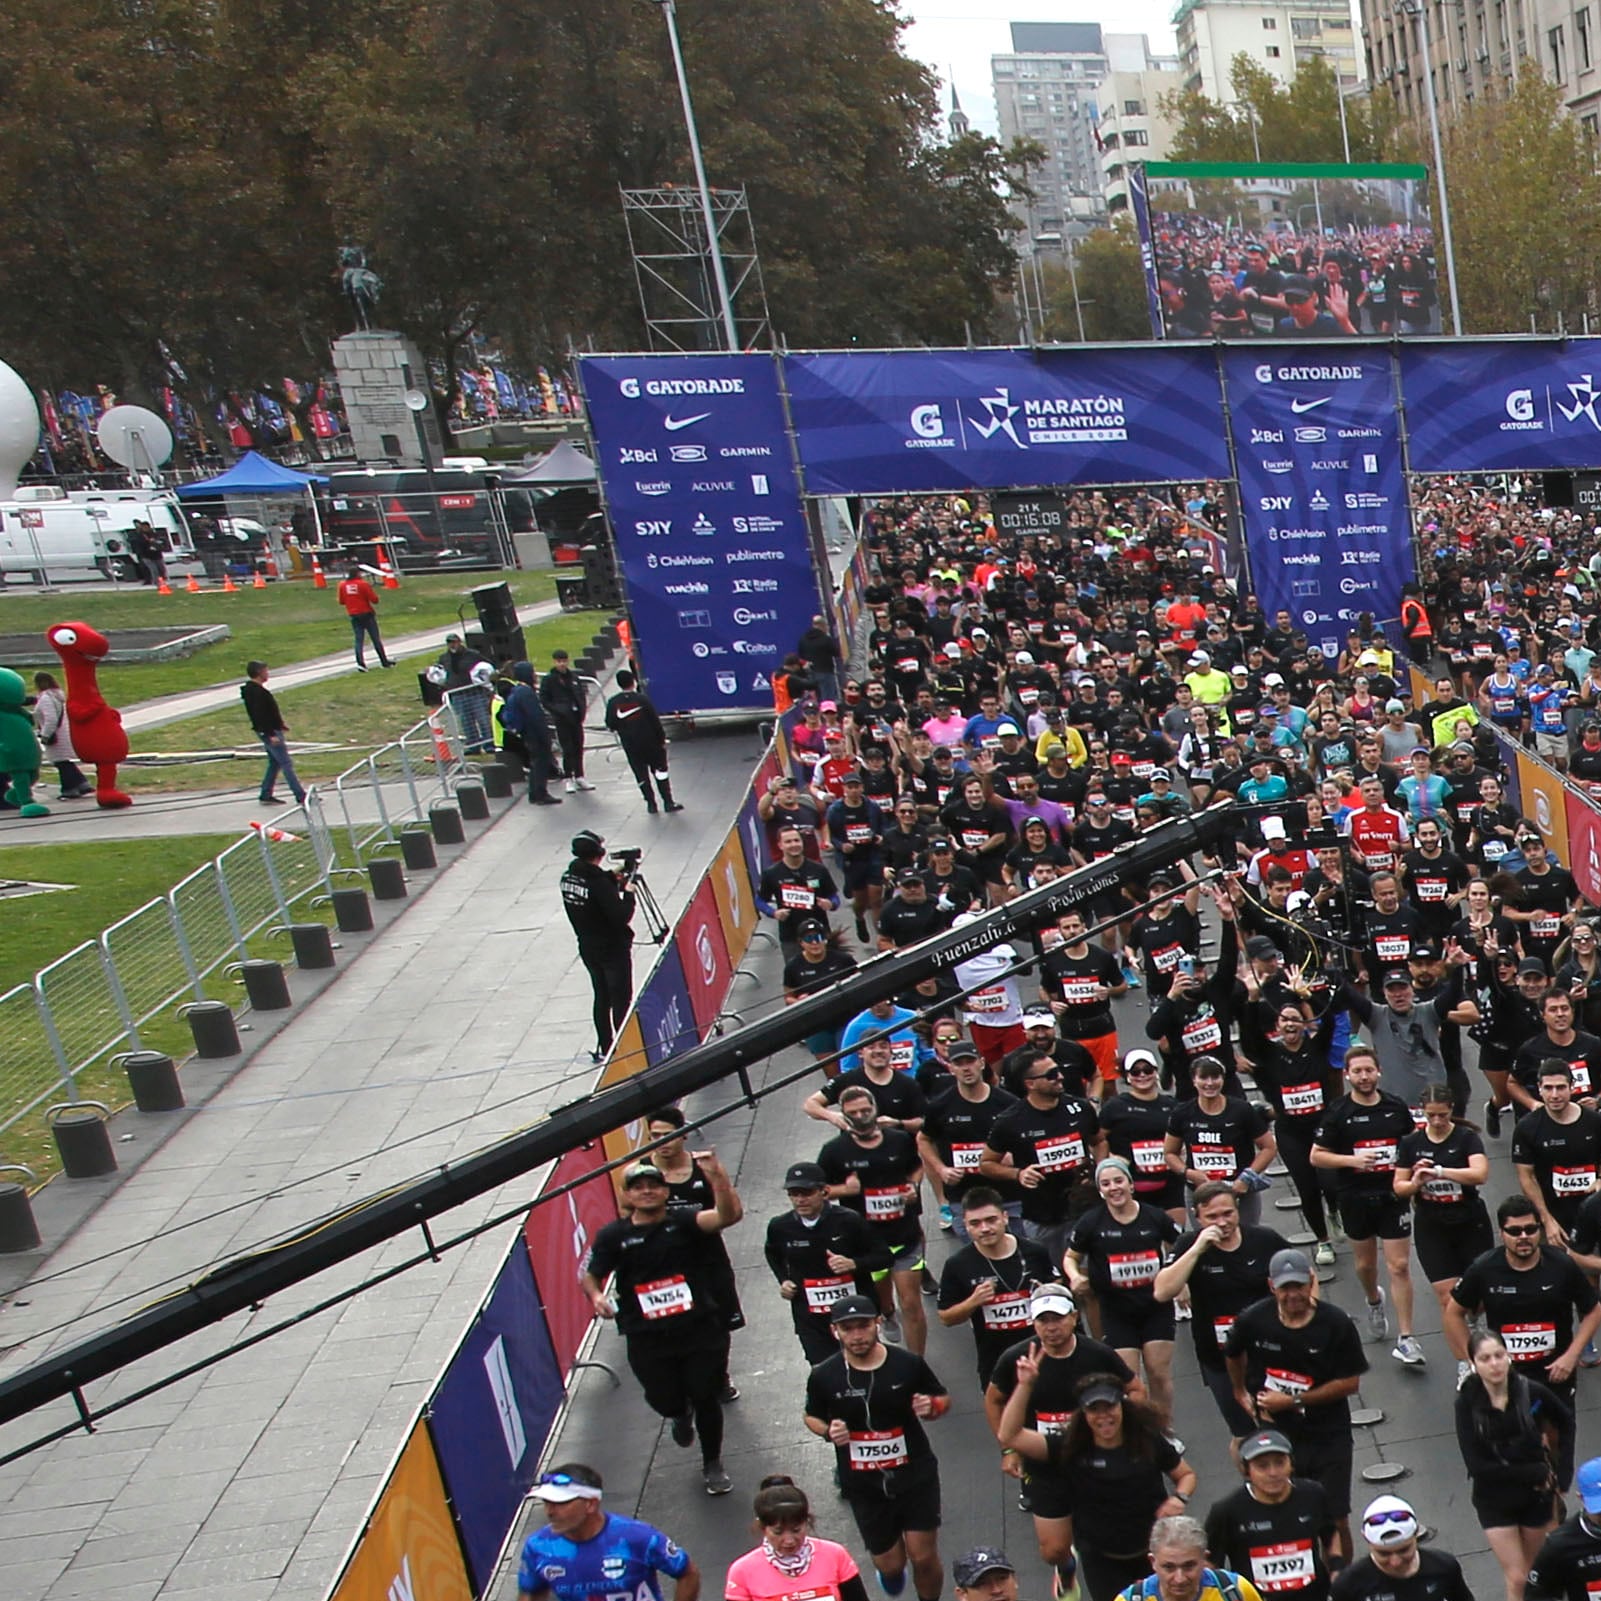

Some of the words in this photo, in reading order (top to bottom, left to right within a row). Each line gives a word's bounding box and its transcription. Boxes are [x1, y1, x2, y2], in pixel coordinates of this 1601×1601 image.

[1278, 366, 1362, 380] GATORADE
[646, 378, 745, 395] GATORADE
[1024, 395, 1124, 415] MARATÓN
[1027, 416, 1047, 429] DE
[1050, 415, 1125, 428] SANTIAGO
[1500, 421, 1543, 430] GATORADE
[1033, 431, 1078, 441] CHILE
[1088, 431, 1124, 440] 2024
[1263, 430, 1284, 443] Bci
[1338, 429, 1381, 438] GARMIN
[905, 438, 955, 448] GATORADE
[635, 448, 658, 463] Bci
[720, 447, 771, 457] GARMIN
[692, 482, 735, 492] ACUVUE
[1018, 504, 1031, 513] 21
[1033, 504, 1041, 512] K
[1260, 497, 1292, 510] SKY
[1001, 512, 1061, 528] 00:16:08
[635, 521, 672, 535] SKY
[726, 551, 784, 564] publimetro
[1288, 1092, 1317, 1107] 18411
[1198, 1131, 1222, 1144] SOLE
[1044, 1146, 1079, 1163] 15902
[1556, 1175, 1591, 1189] 16435
[1116, 1264, 1154, 1278] 19190
[814, 1288, 849, 1300] 17138
[992, 1303, 1028, 1318] 14771
[1508, 1335, 1549, 1349] 17994
[857, 1443, 900, 1456] 17506
[1261, 1557, 1305, 1574] 17397
